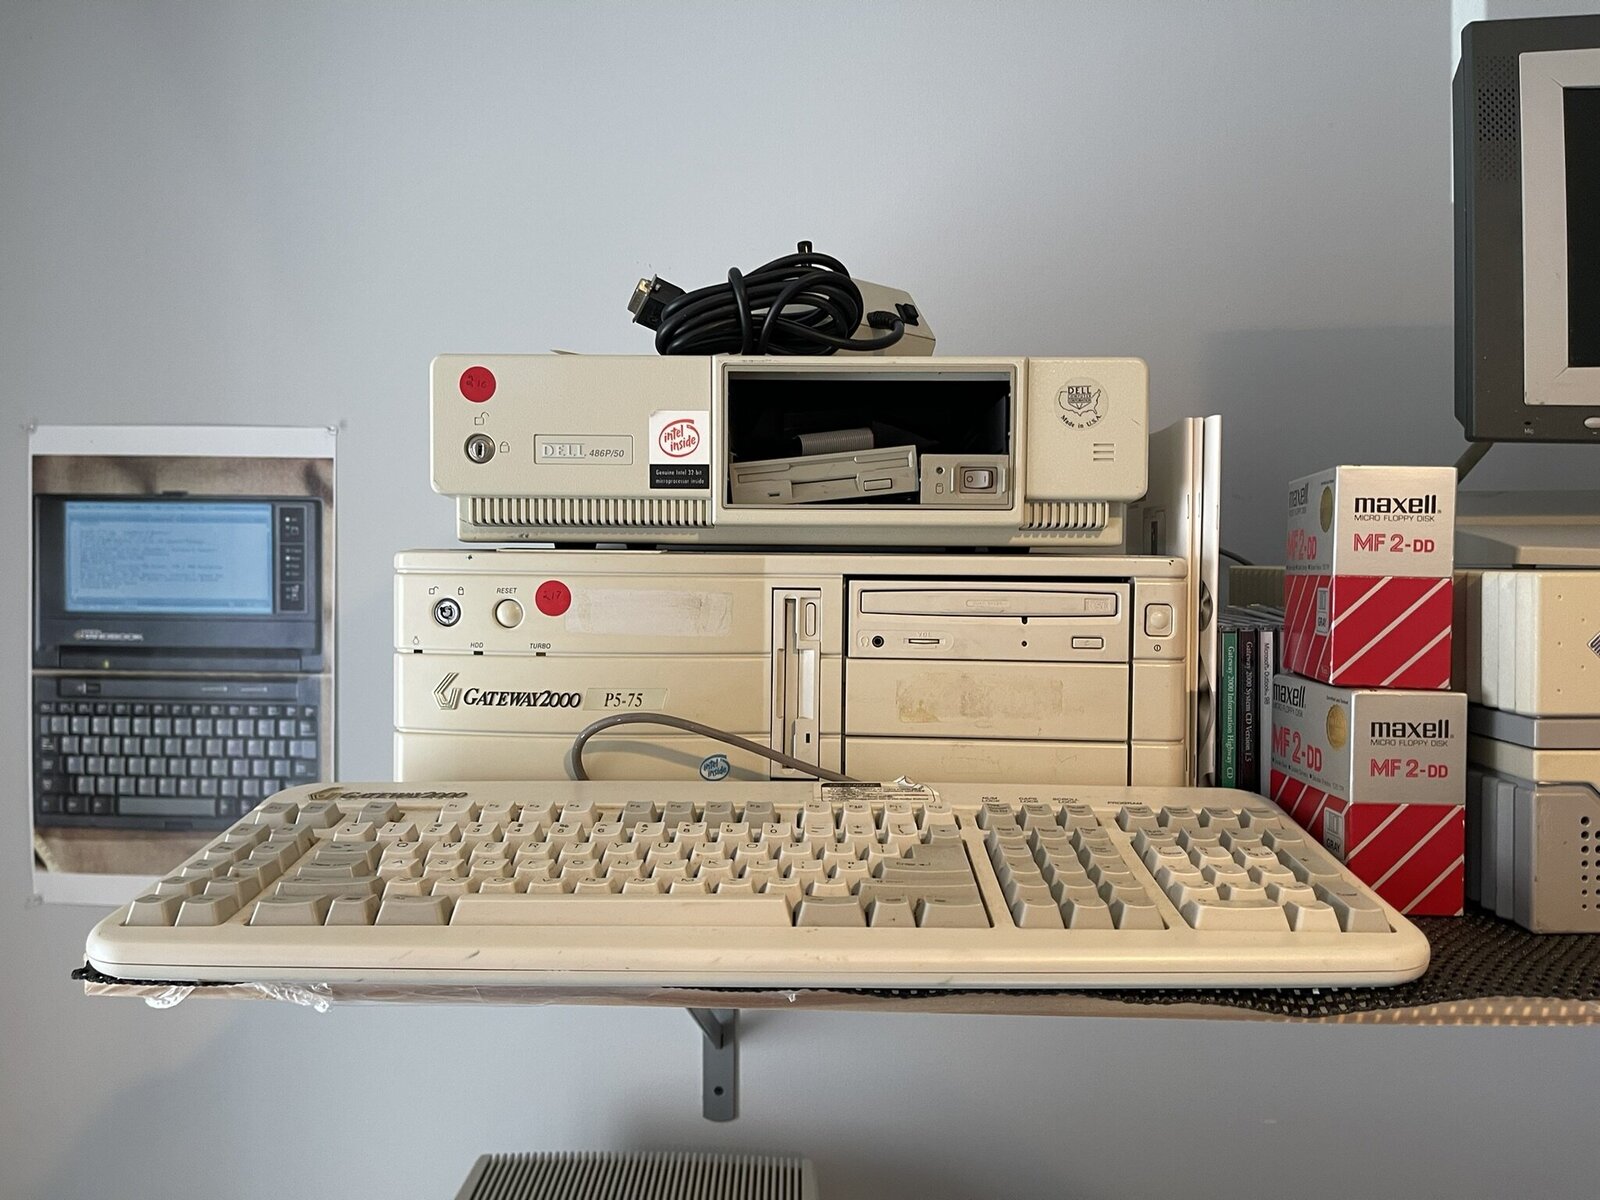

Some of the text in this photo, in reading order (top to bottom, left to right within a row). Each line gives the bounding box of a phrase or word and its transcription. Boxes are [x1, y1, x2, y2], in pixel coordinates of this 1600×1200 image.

[1068, 386, 1092, 394] DELL
[664, 424, 684, 442] intel
[542, 442, 624, 458] DELL 486P/50
[670, 434, 696, 452] inside
[1354, 494, 1436, 514] maxell
[1416, 514, 1435, 522] DISK
[1354, 533, 1386, 552] MF
[1226, 646, 1234, 675] Gateway
[604, 692, 644, 708] P5-75
[1273, 683, 1306, 708] maxell
[1246, 712, 1252, 724] CD
[1370, 720, 1448, 738] maxell
[1225, 735, 1234, 764] Highway
[1273, 723, 1290, 758] MF
[1226, 766, 1234, 778] CD
[1370, 758, 1402, 778] MF
